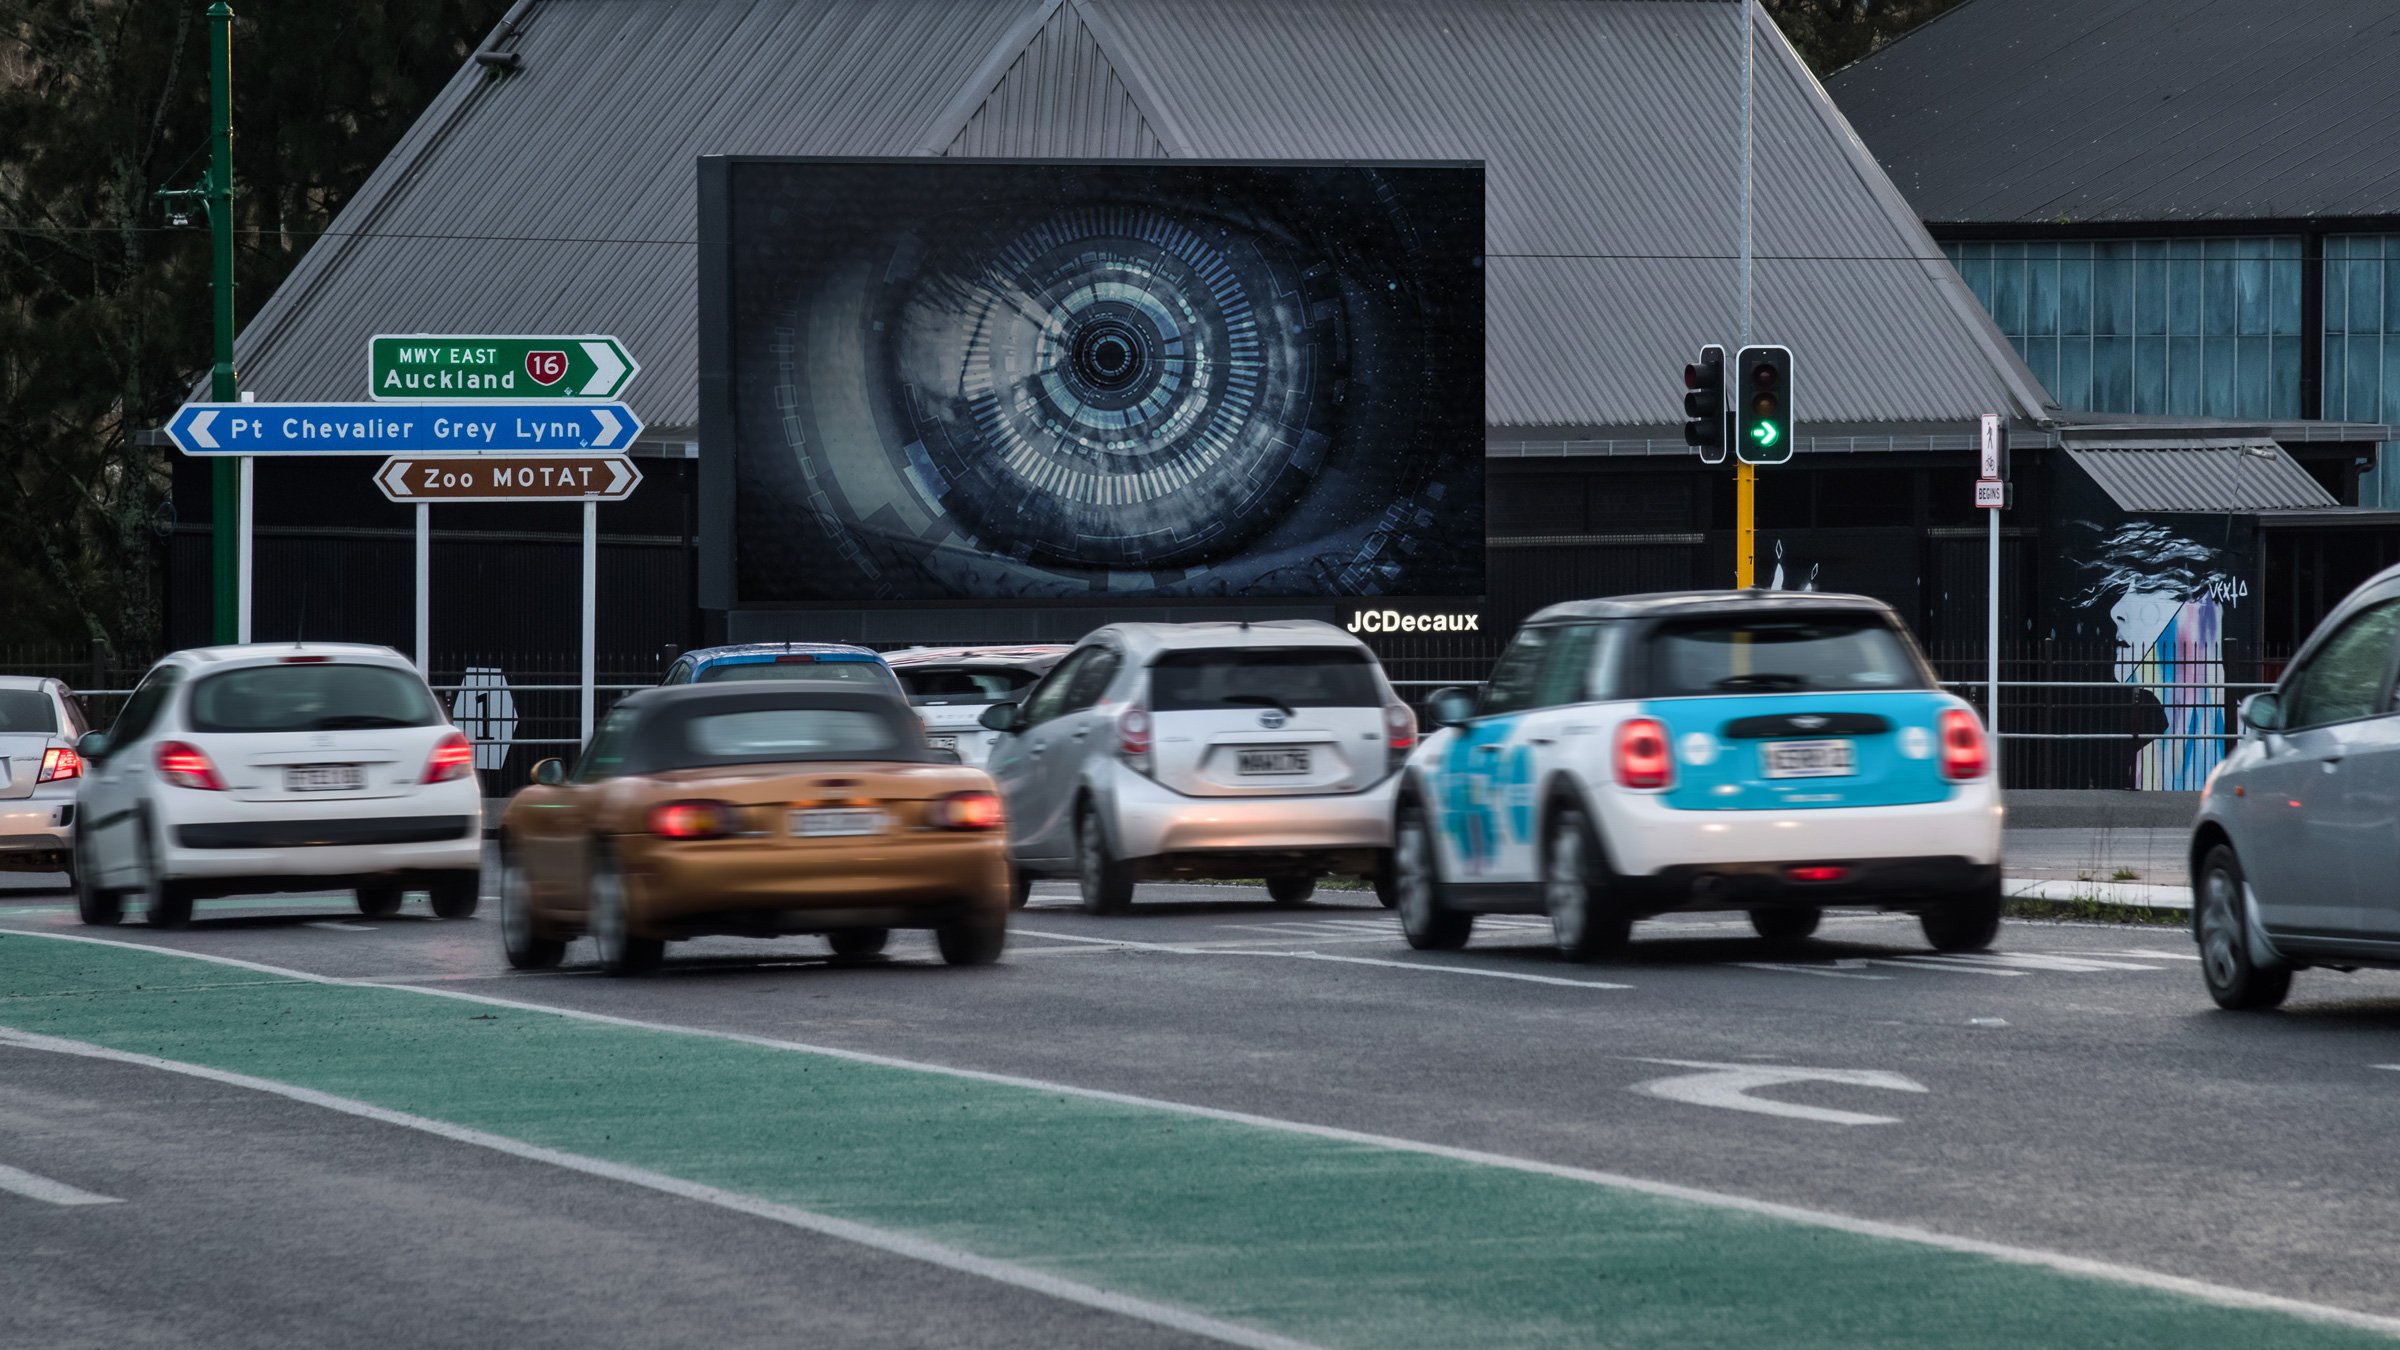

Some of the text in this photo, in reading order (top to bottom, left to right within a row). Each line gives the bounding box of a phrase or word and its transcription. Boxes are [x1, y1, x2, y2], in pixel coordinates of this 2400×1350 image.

[399, 348, 497, 364] MWY EAST
[533, 355, 560, 375] 16
[383, 368, 515, 389] Auckland
[231, 417, 581, 443] Pt Chevalier Grey Lynn
[423, 466, 593, 488] Zoo MOTAT
[1978, 487, 2001, 500] BEGINS
[1346, 610, 1480, 633] JCDecaux
[474, 692, 495, 741] 1
